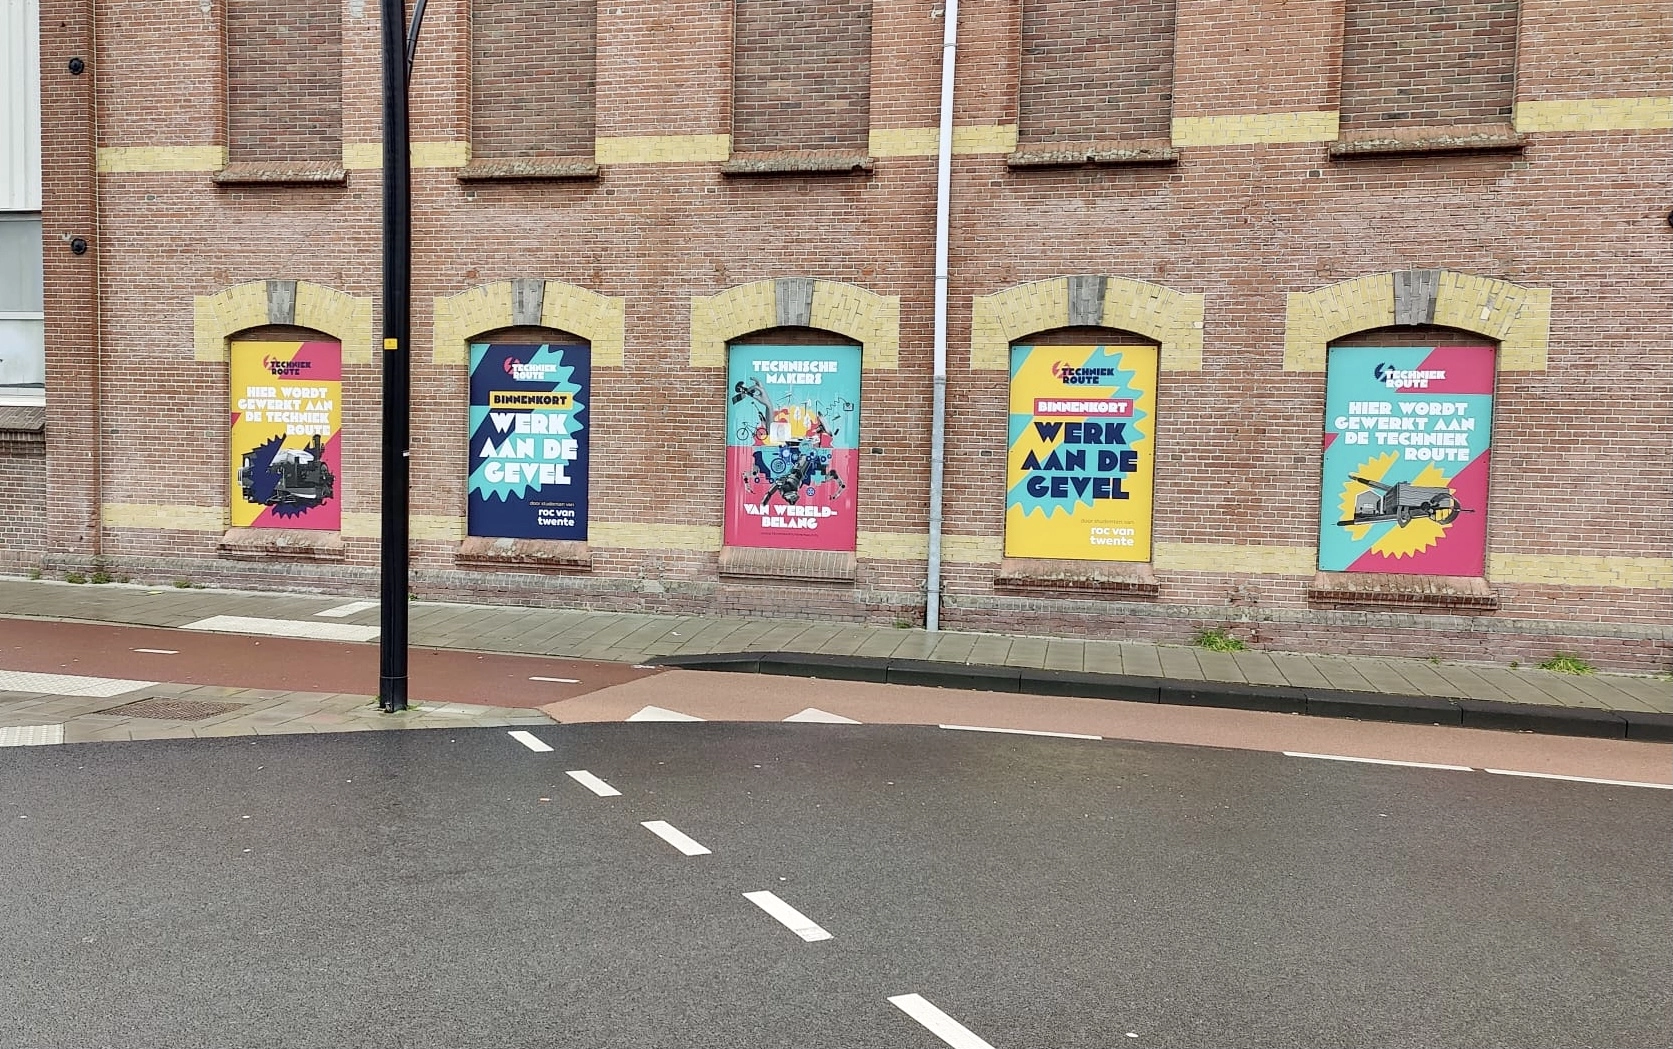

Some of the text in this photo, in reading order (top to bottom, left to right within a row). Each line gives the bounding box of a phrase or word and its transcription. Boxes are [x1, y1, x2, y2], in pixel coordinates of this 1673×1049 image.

[511, 363, 557, 372] TECHNIEK
[752, 360, 838, 373] TECHNISCHE
[1061, 367, 1114, 376] TECHNIEK
[512, 371, 545, 380] ROUTE
[766, 373, 822, 385] MAKERS
[1062, 376, 1099, 385] ROUTE
[1384, 370, 1446, 380] TECHNIEK
[1385, 379, 1428, 388] ROUTE
[246, 386, 328, 398] HIER WORDT
[237, 399, 333, 411] GEWERKT AAN
[494, 395, 567, 405] BINNENKORT
[1038, 401, 1128, 413] BINNENKORT
[1349, 401, 1468, 416] HIER WORDT
[245, 411, 329, 423] DE TECHNIEK
[489, 413, 568, 434] WERK
[1334, 416, 1475, 431] GEWERKT AAN
[286, 424, 330, 436] ROUTE
[1033, 422, 1127, 445] WERK
[1344, 432, 1468, 446] DE TECHNIEK
[479, 437, 577, 460] AAN DE
[1404, 447, 1470, 462] ROUTE
[1021, 449, 1138, 472] AAN DE
[484, 461, 571, 485] GEVEL
[1026, 475, 1130, 500] GEVEL
[538, 509, 575, 517] roc van
[743, 503, 838, 518] VAN WERELD-
[538, 517, 575, 526] twente
[761, 517, 818, 529] BELANG
[1091, 527, 1135, 536] roc van
[1090, 536, 1135, 546] twente
